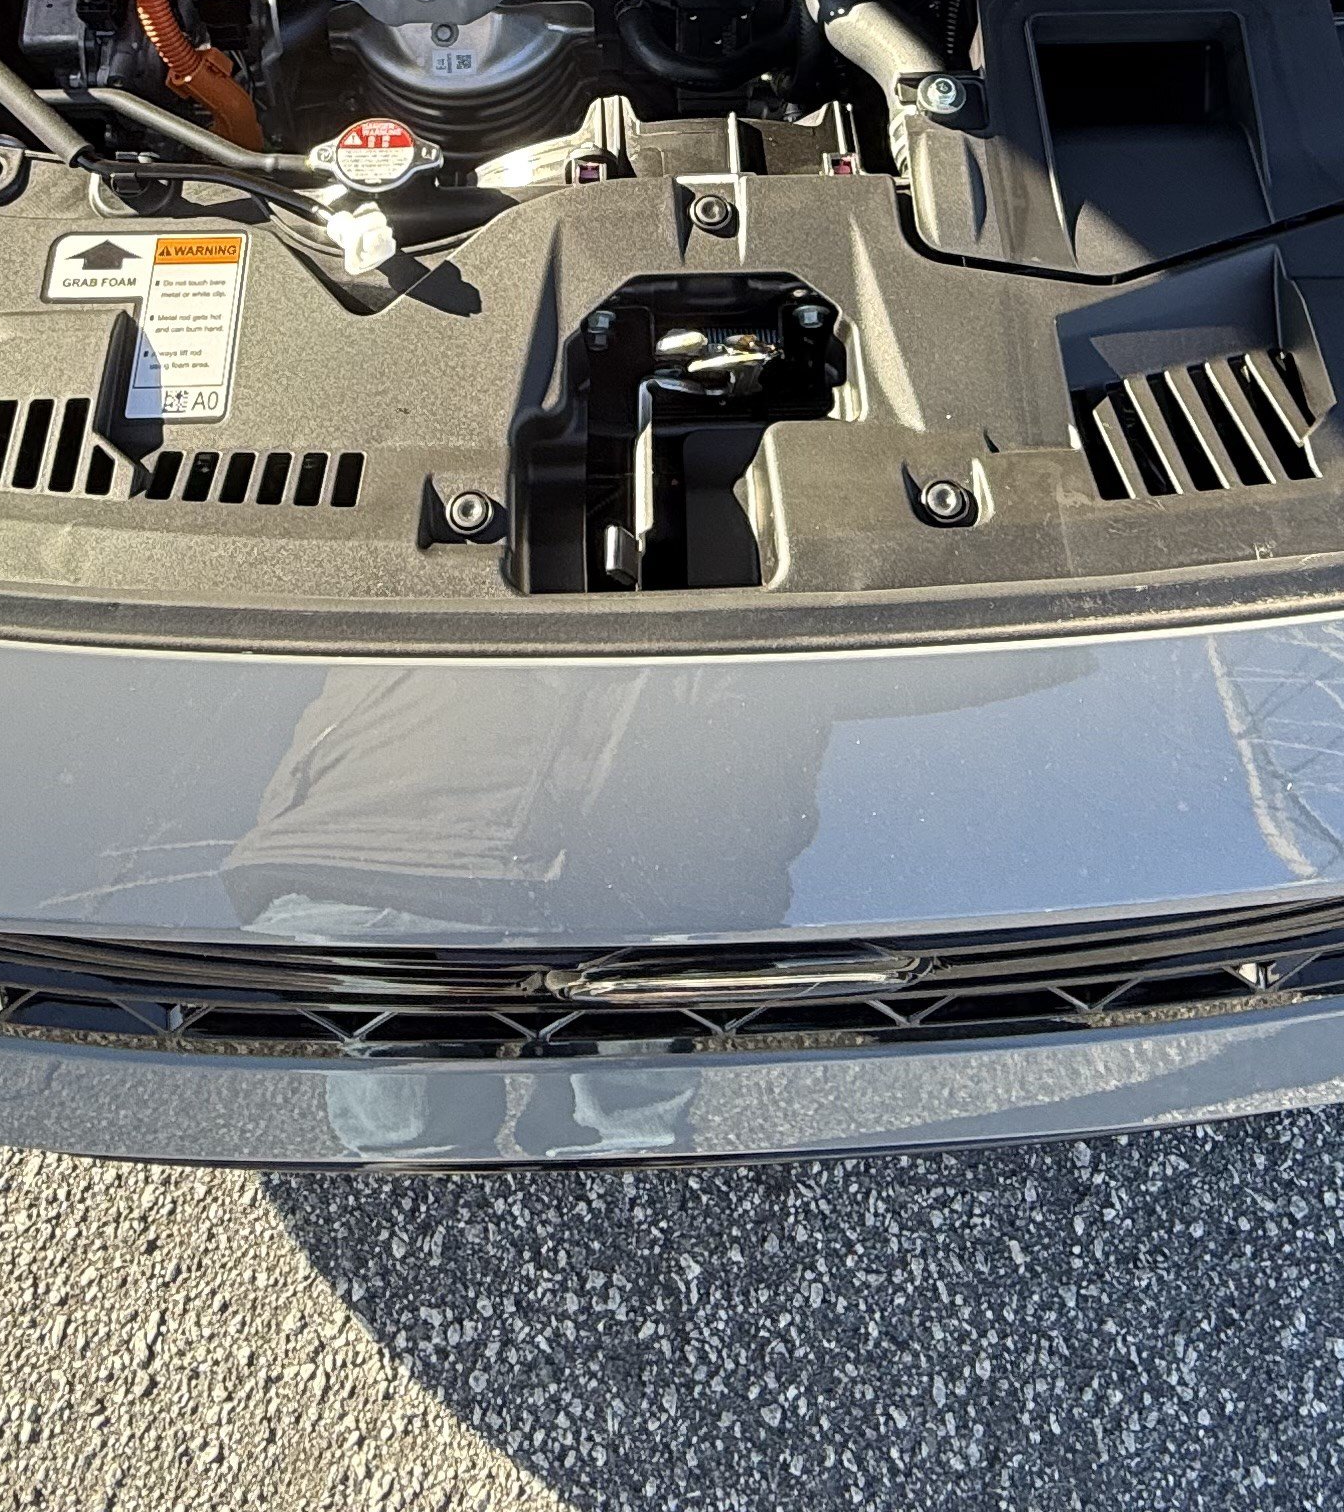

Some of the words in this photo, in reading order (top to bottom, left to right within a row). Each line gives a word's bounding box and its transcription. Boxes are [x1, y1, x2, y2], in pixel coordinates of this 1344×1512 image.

[174, 245, 237, 256] WARNING
[62, 278, 98, 287] GRAB
[101, 277, 137, 287] FOAM
[191, 391, 219, 410] A0
